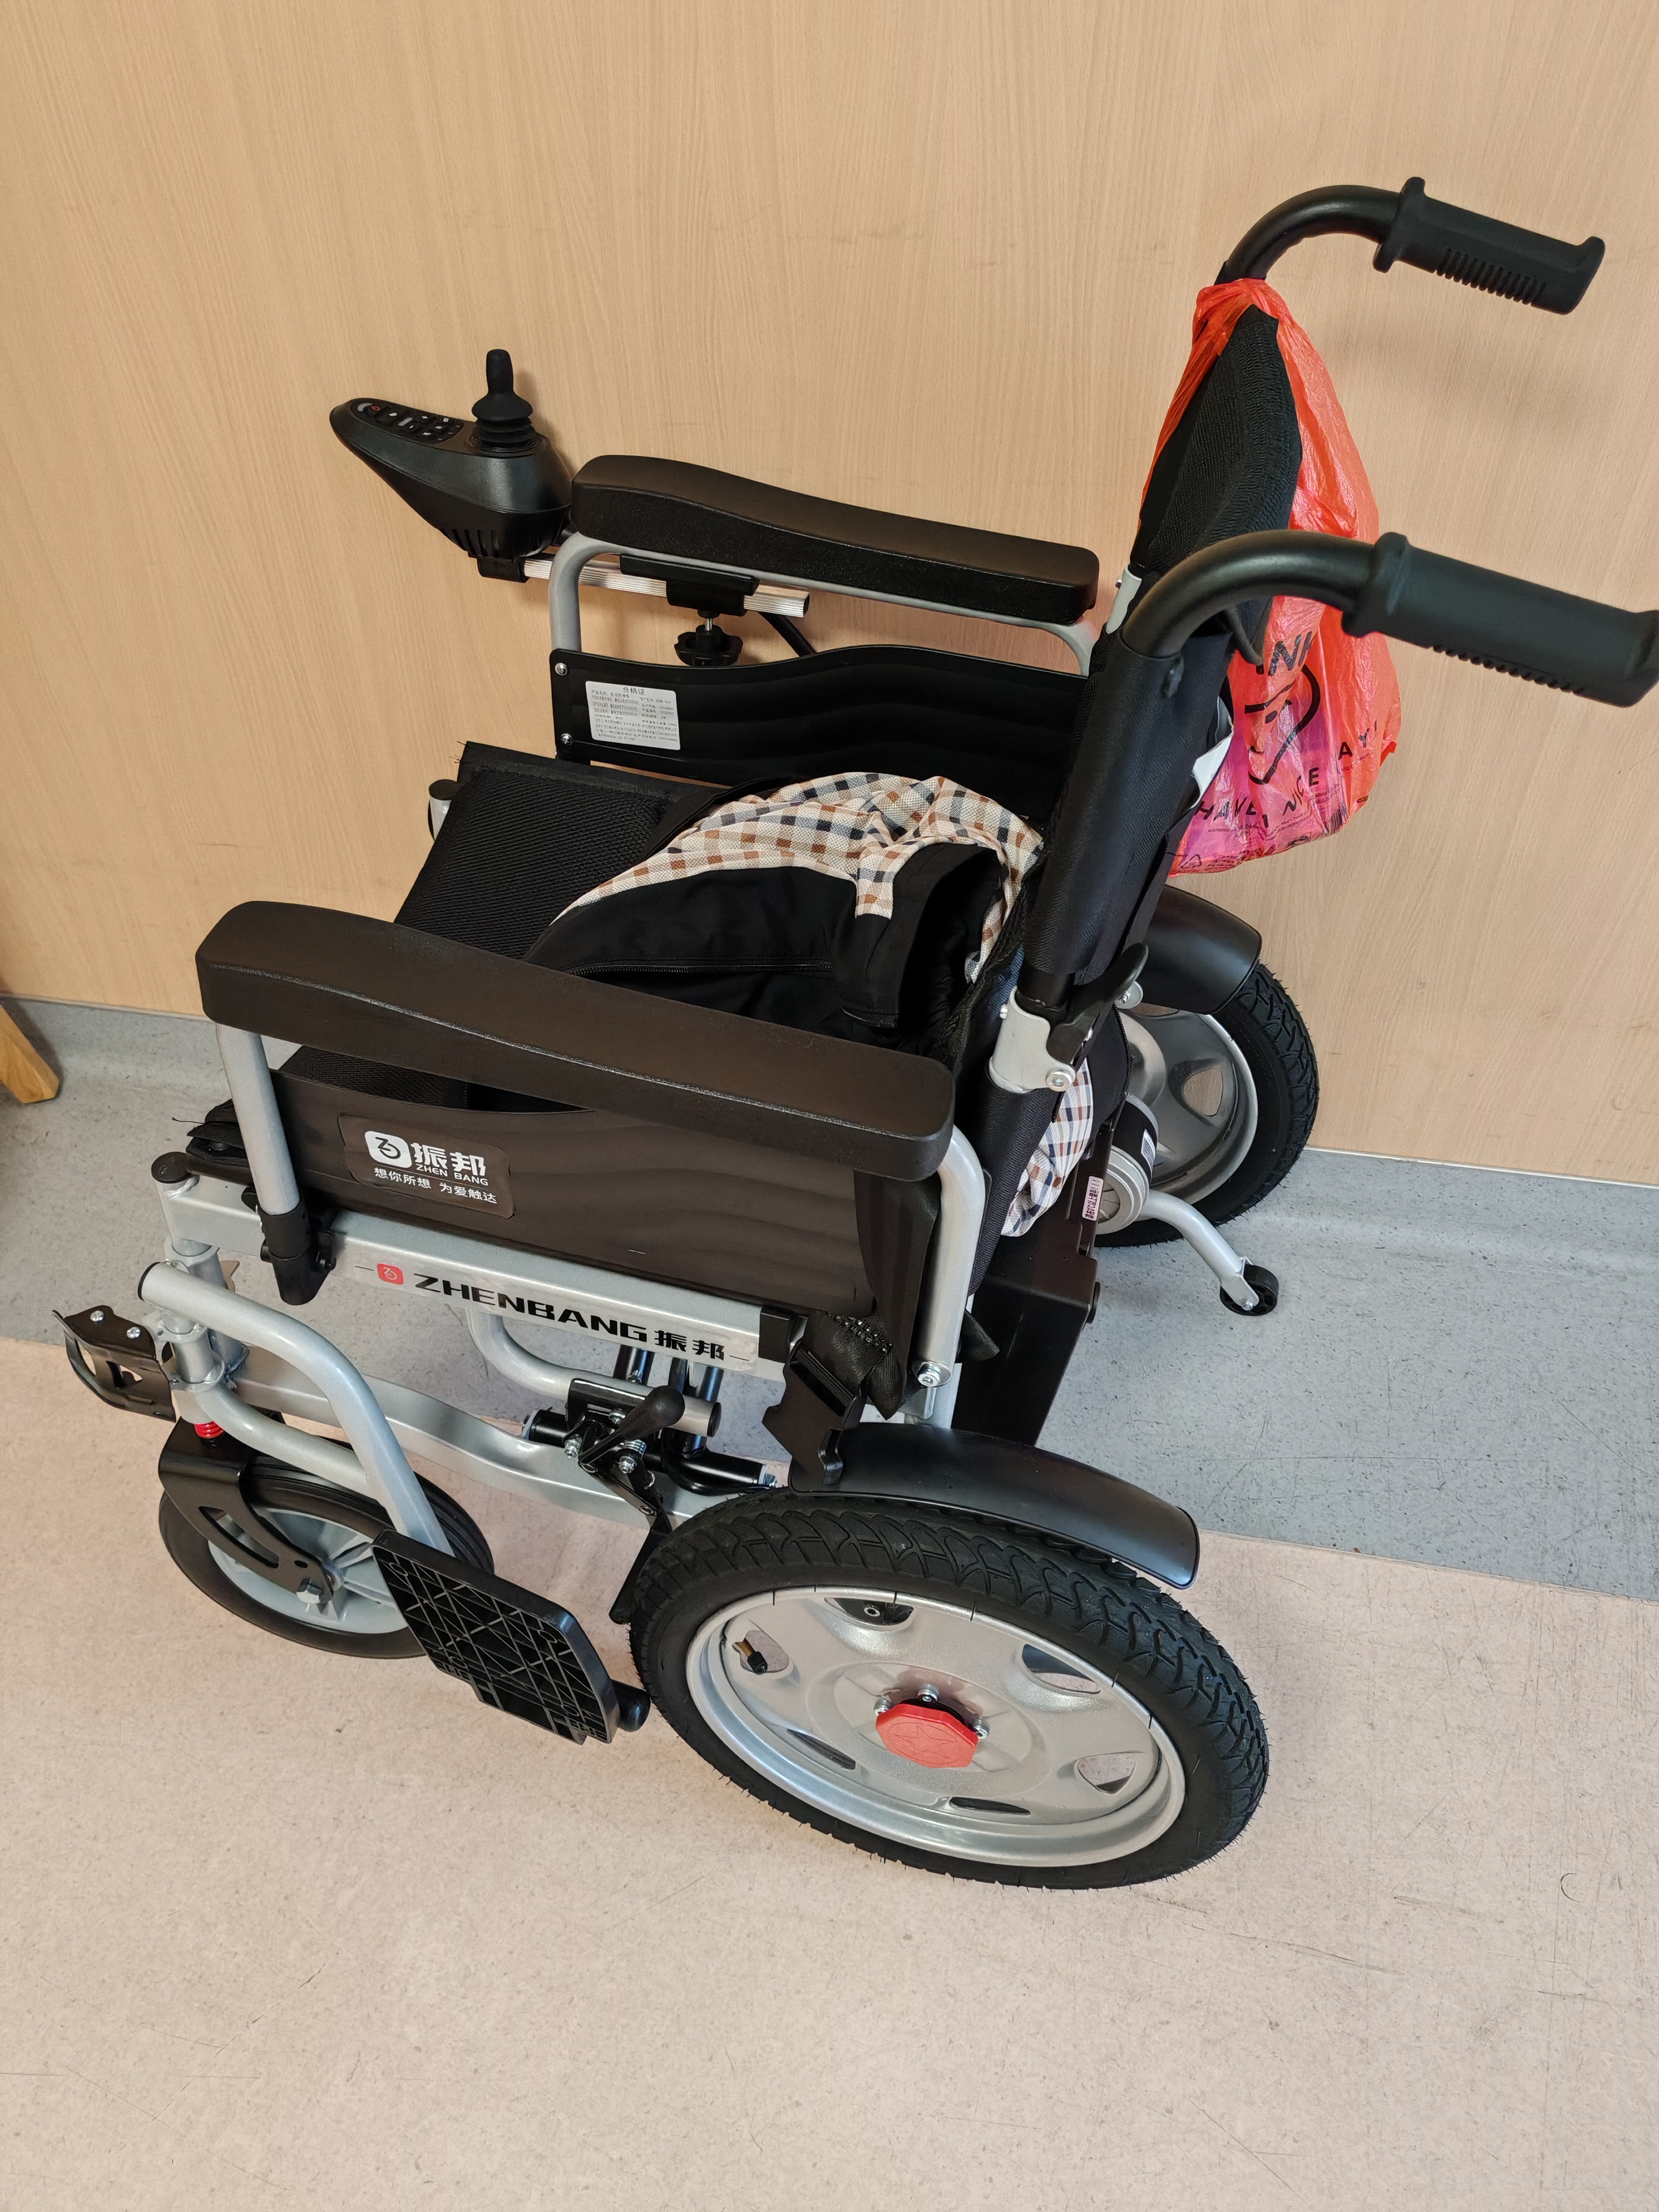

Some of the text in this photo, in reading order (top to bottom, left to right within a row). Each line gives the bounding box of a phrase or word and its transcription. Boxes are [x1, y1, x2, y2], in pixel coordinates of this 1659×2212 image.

[622, 686, 645, 696] 合格证
[1338, 720, 1378, 760] AY!
[410, 1142, 486, 1177] 振邦
[416, 1163, 489, 1186] ZHEN BANG
[374, 1167, 498, 1204] 想你所想 为爱触达
[413, 1273, 725, 1361] ZHENBANG 振邦
